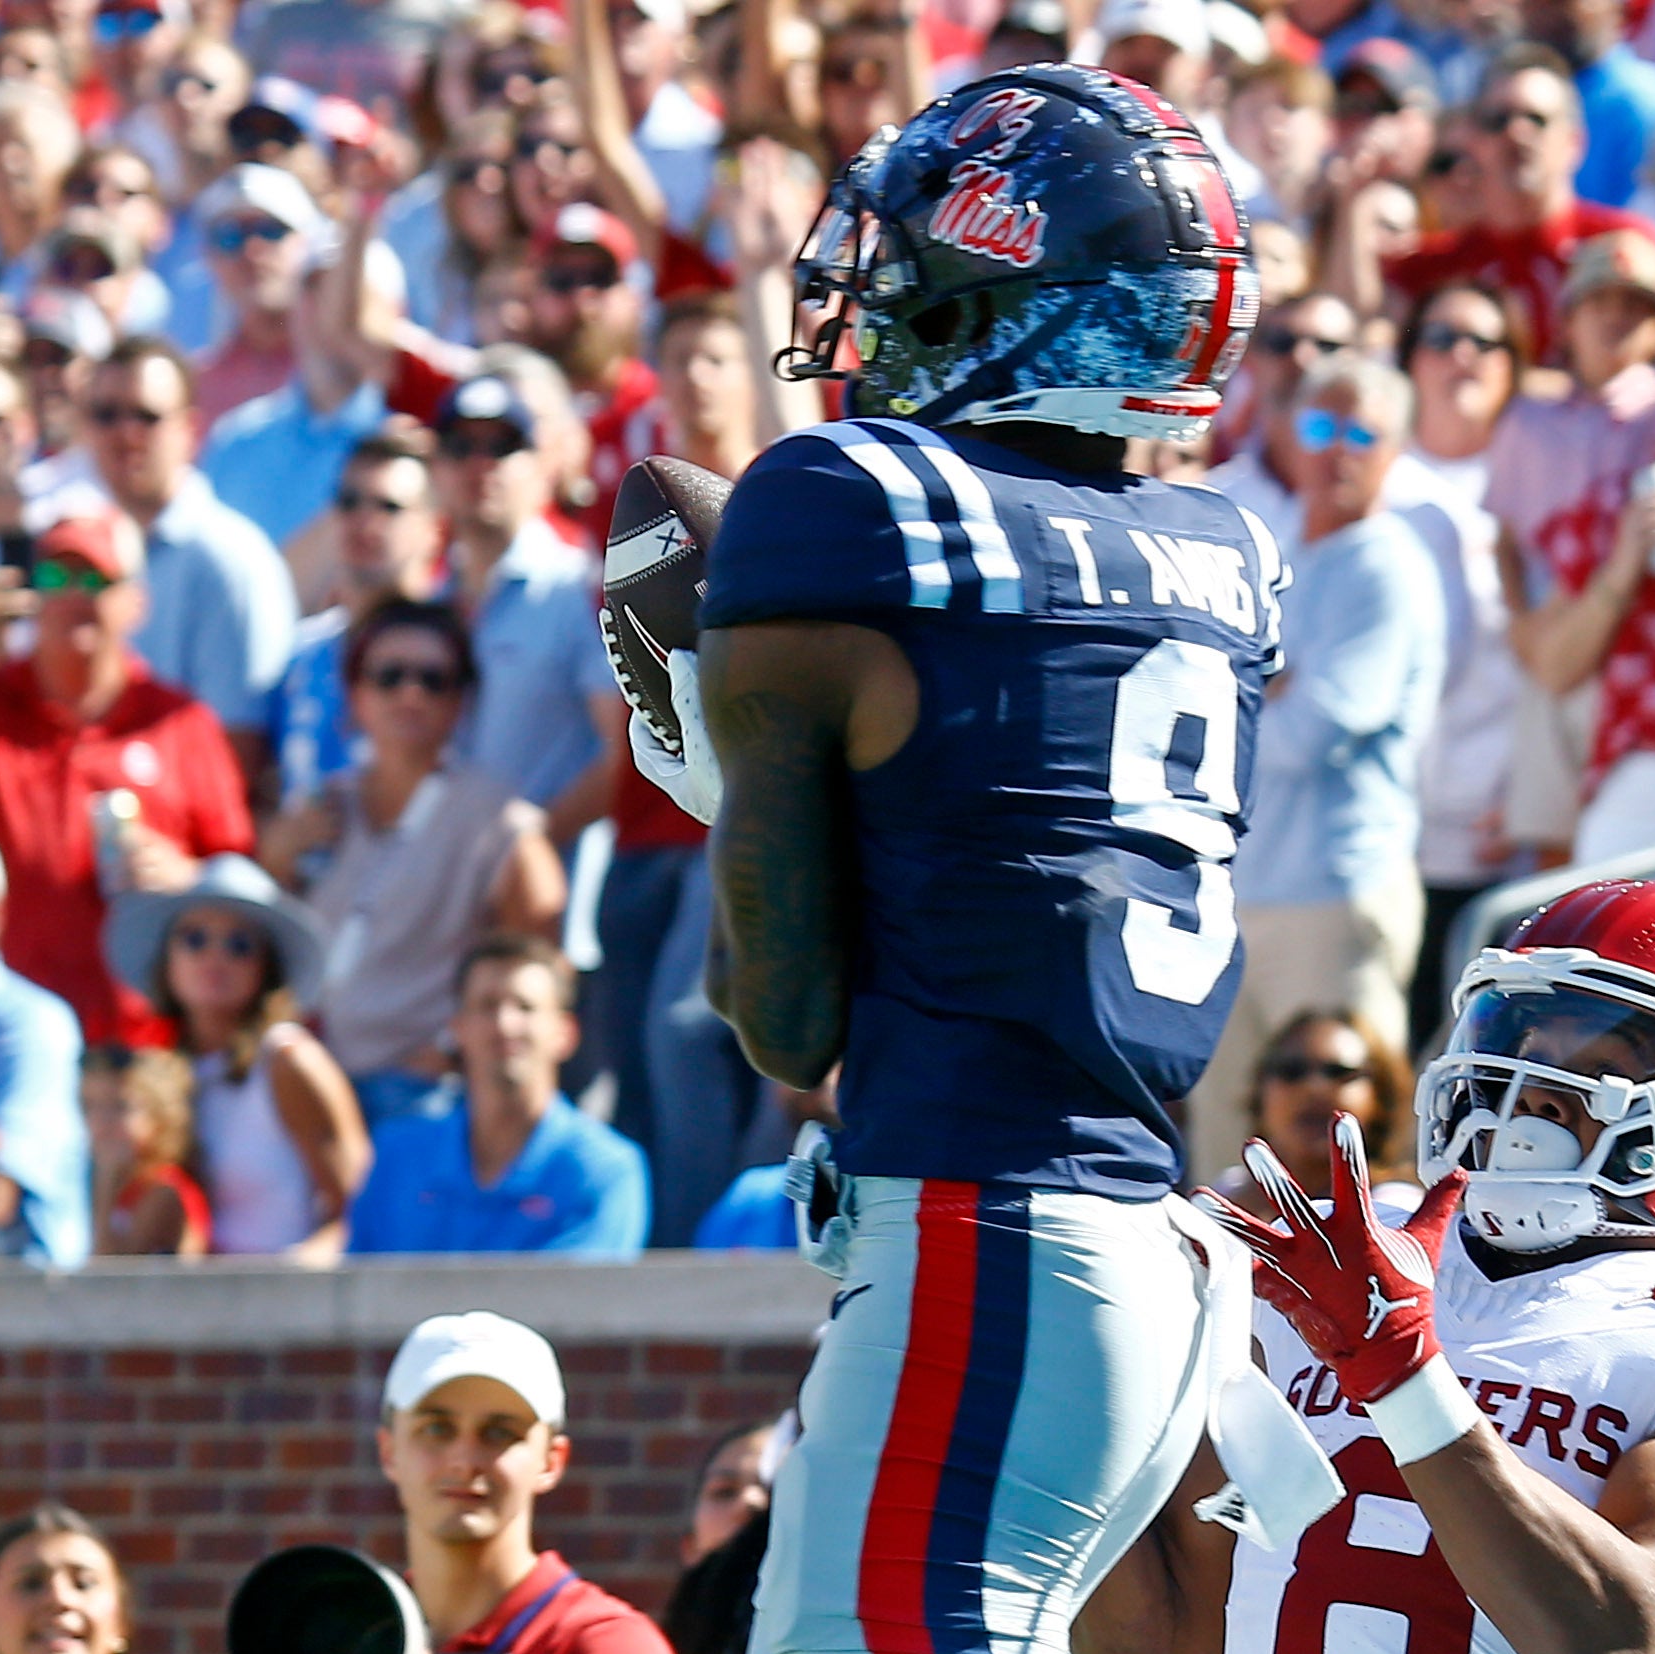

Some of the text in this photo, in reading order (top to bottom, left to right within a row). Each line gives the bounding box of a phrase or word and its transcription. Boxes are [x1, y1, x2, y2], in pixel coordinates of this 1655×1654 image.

[928, 160, 1050, 268] Miss
[1047, 516, 1130, 606] T.
[1108, 638, 1241, 1006] 9
